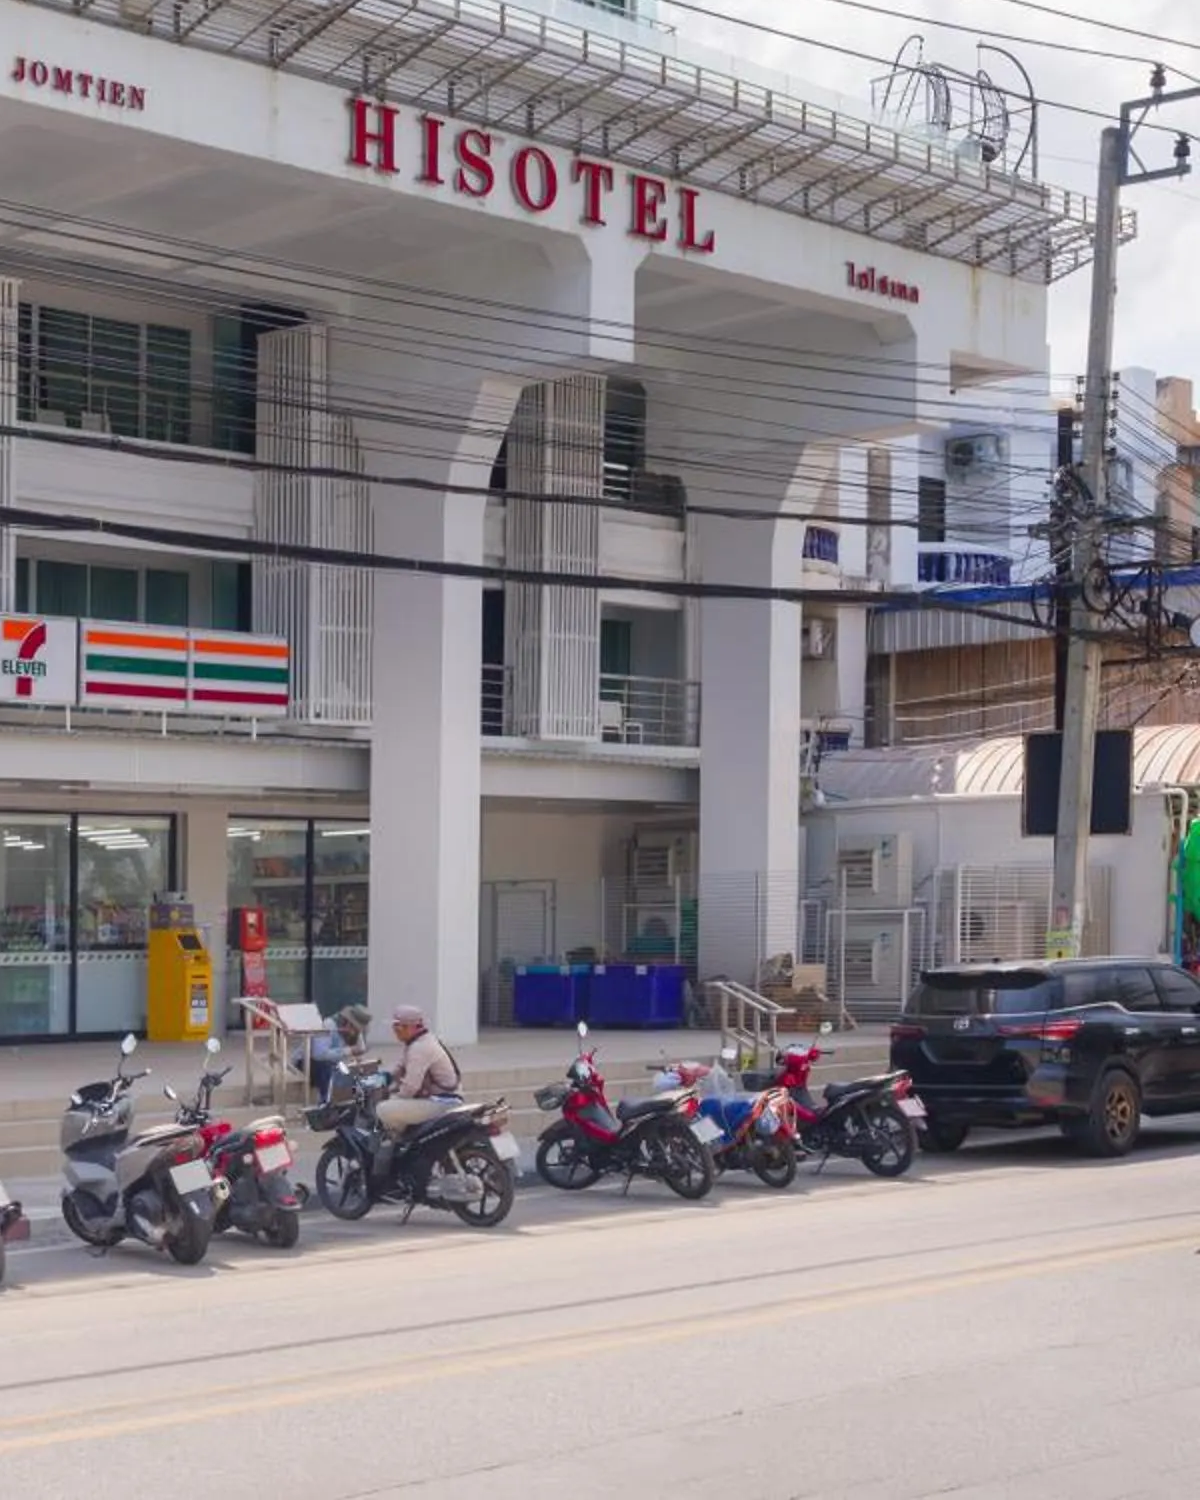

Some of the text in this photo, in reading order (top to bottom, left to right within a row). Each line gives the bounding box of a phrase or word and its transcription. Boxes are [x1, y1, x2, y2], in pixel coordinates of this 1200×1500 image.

[12, 56, 145, 111] JOMTIEN
[350, 97, 714, 253] HISOTEL
[3, 621, 47, 697] 7
